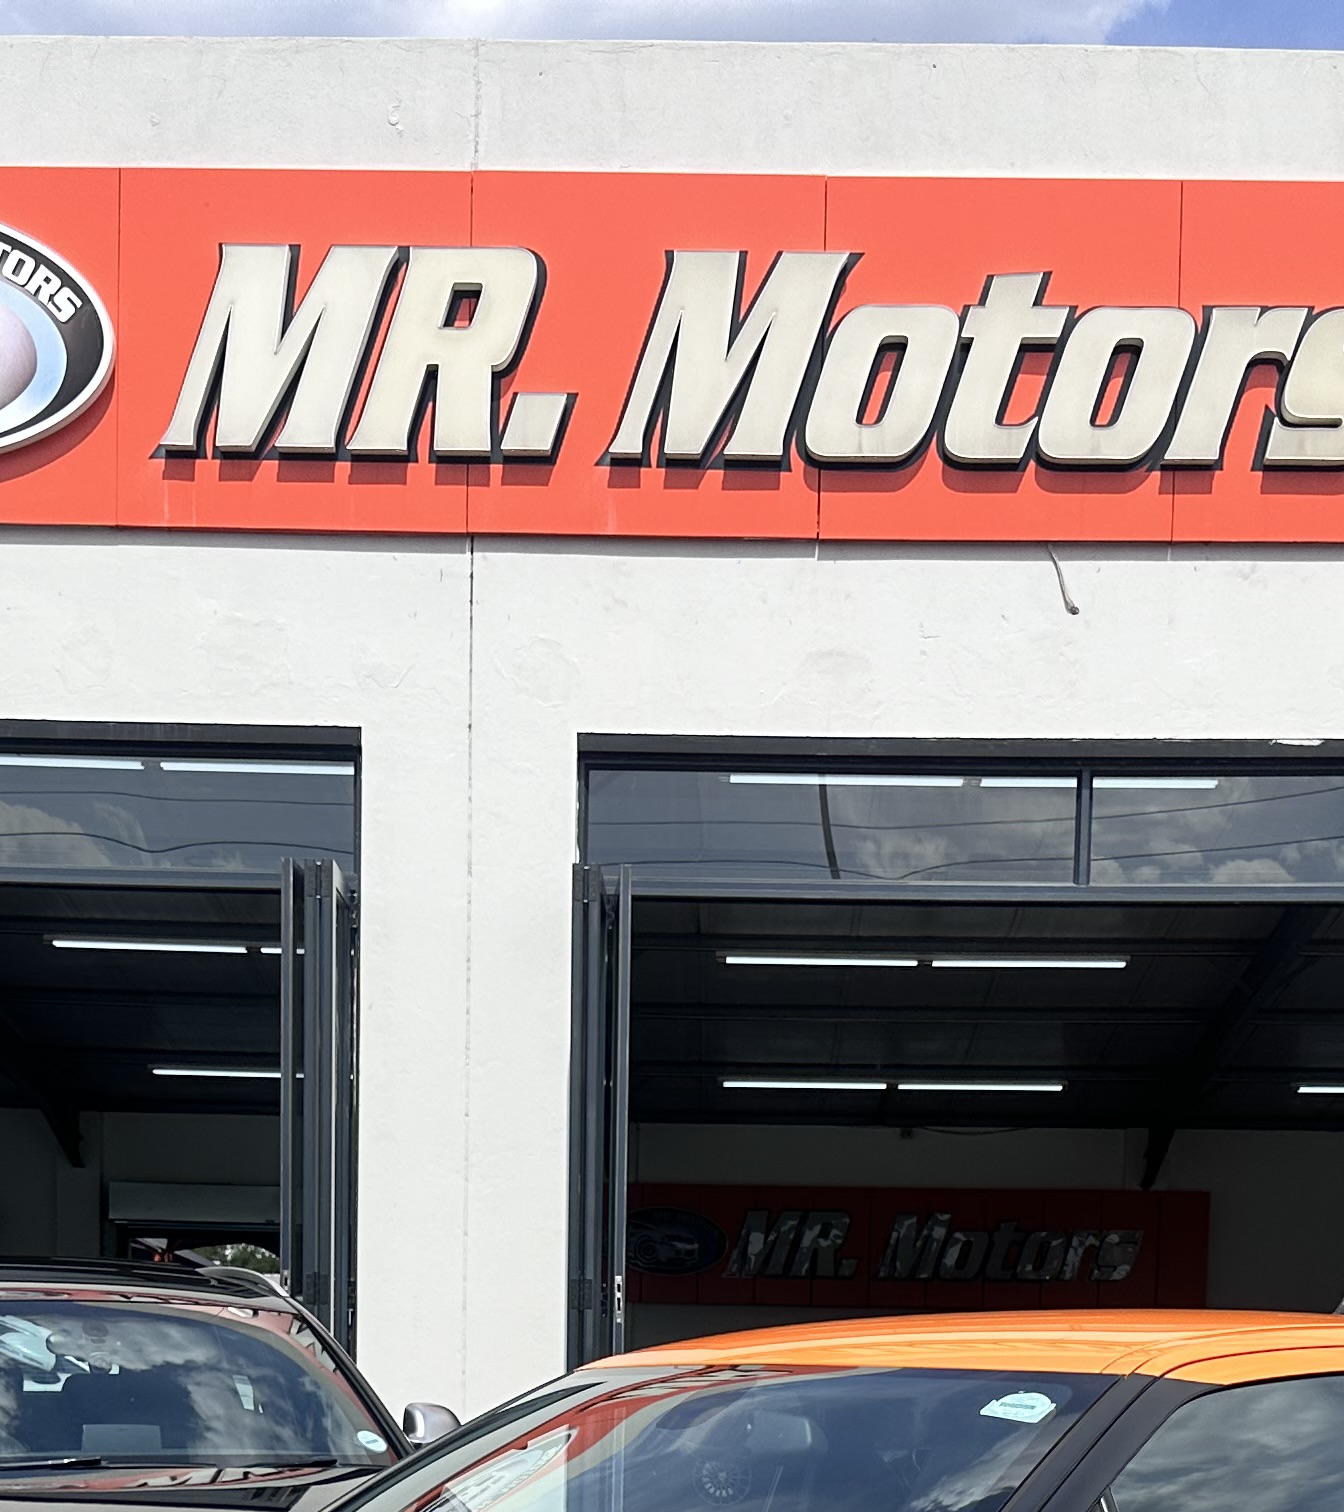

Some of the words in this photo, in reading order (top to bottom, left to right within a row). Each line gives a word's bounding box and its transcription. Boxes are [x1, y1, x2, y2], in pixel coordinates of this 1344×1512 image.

[156, 243, 573, 460] MR.
[722, 1209, 857, 1281] MR.
[877, 1212, 1144, 1283] Motors
